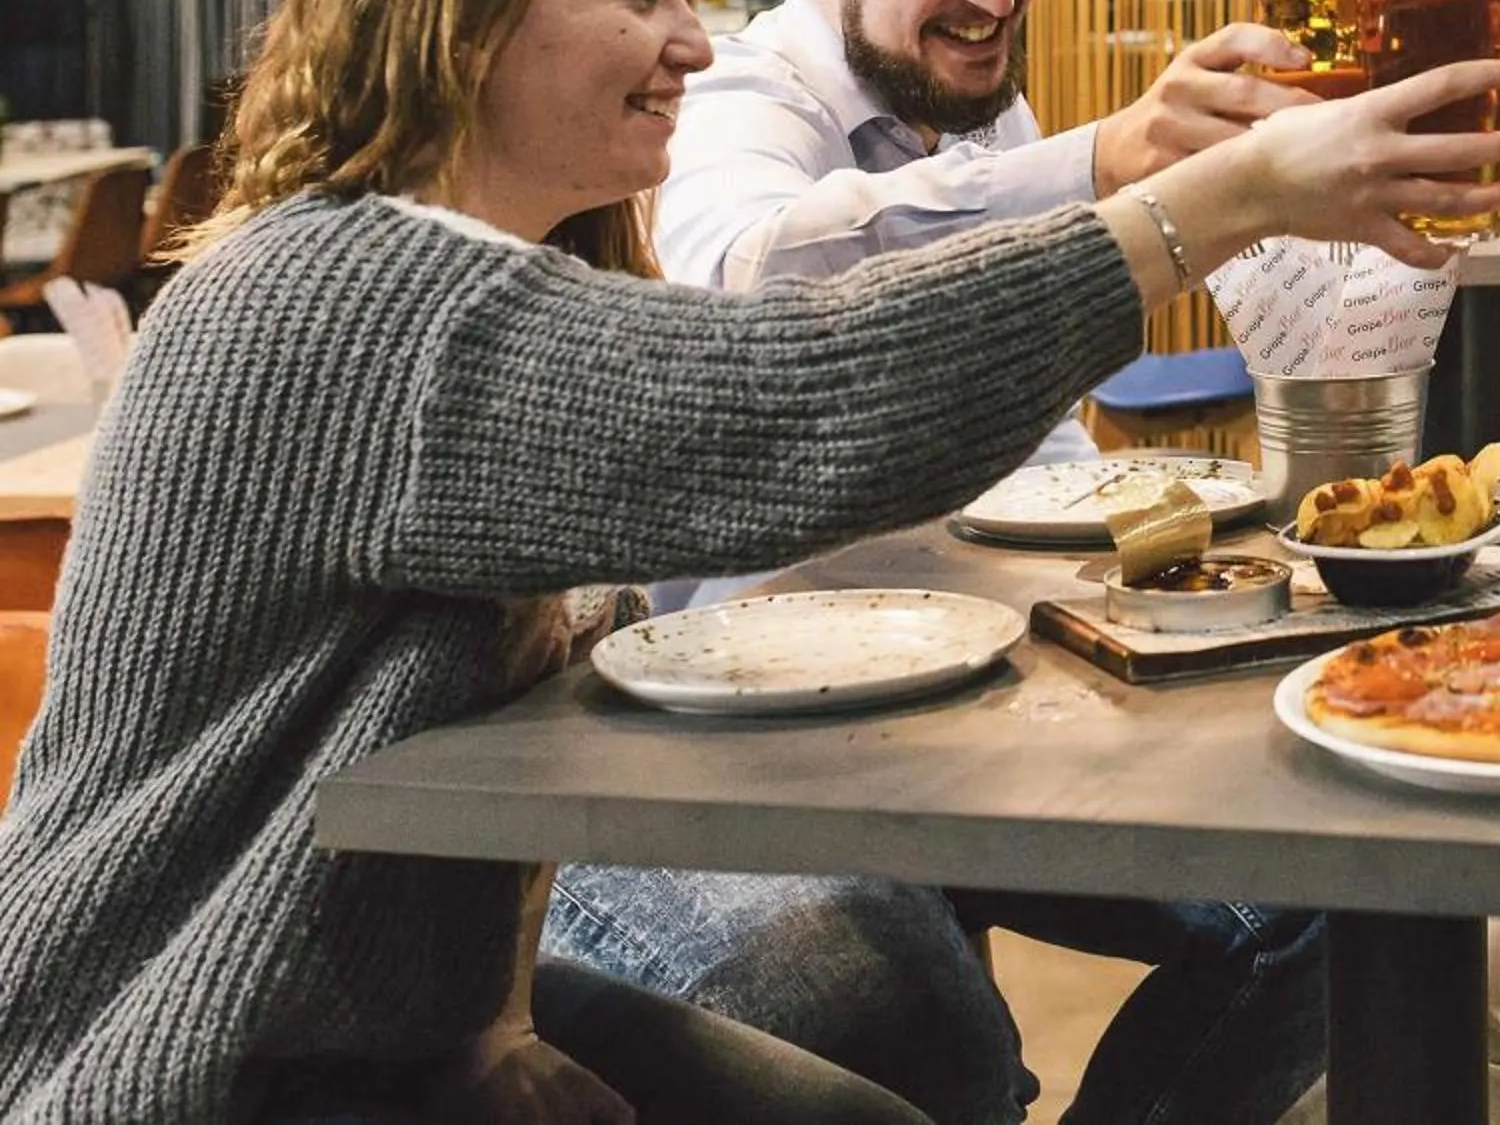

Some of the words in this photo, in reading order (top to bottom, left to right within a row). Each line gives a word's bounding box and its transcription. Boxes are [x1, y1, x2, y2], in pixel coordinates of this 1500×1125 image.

[1347, 320, 1382, 336] Grape
[1282, 348, 1309, 375] Grape
[1351, 347, 1388, 362] Grape
